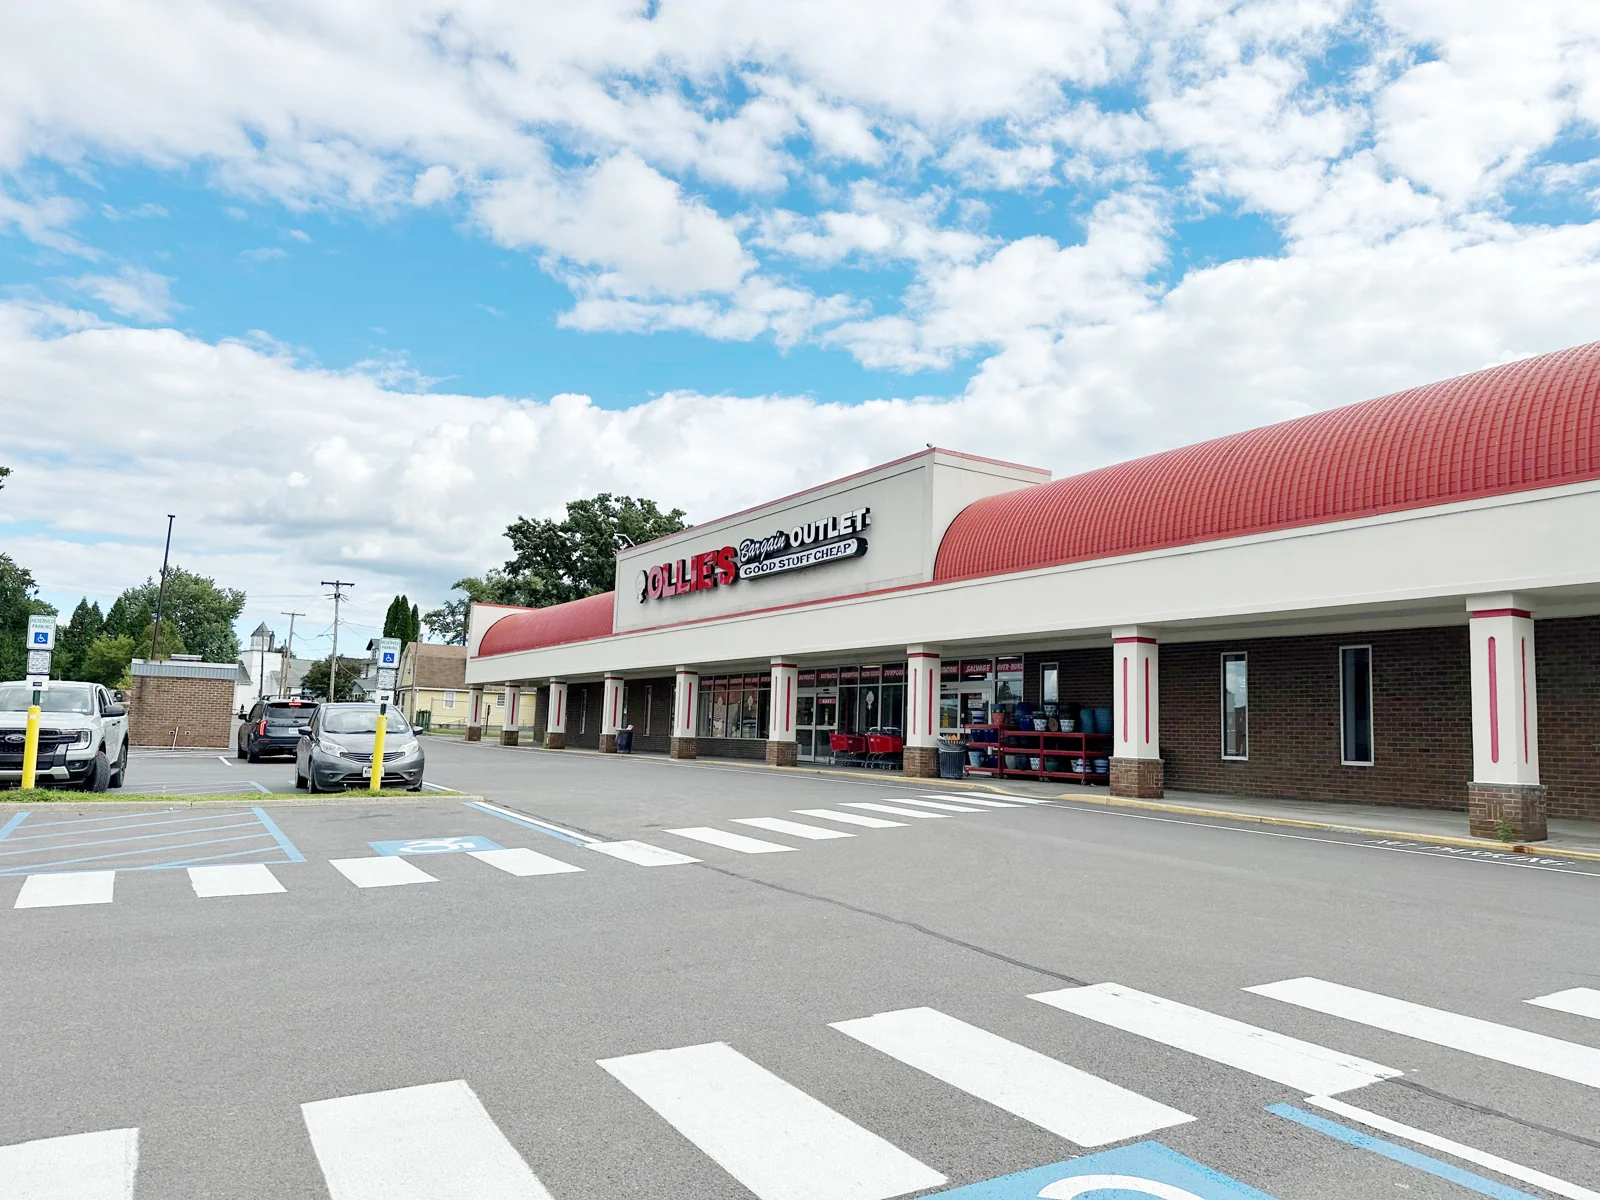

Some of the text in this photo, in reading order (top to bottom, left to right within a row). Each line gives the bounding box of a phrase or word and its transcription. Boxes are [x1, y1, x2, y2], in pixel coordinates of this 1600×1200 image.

[740, 507, 867, 562] Bargain OUTLET
[647, 546, 737, 600] OLLIE'S
[744, 543, 852, 576] GOOD STUFF CHEAP
[966, 664, 991, 673] SALVAGE
